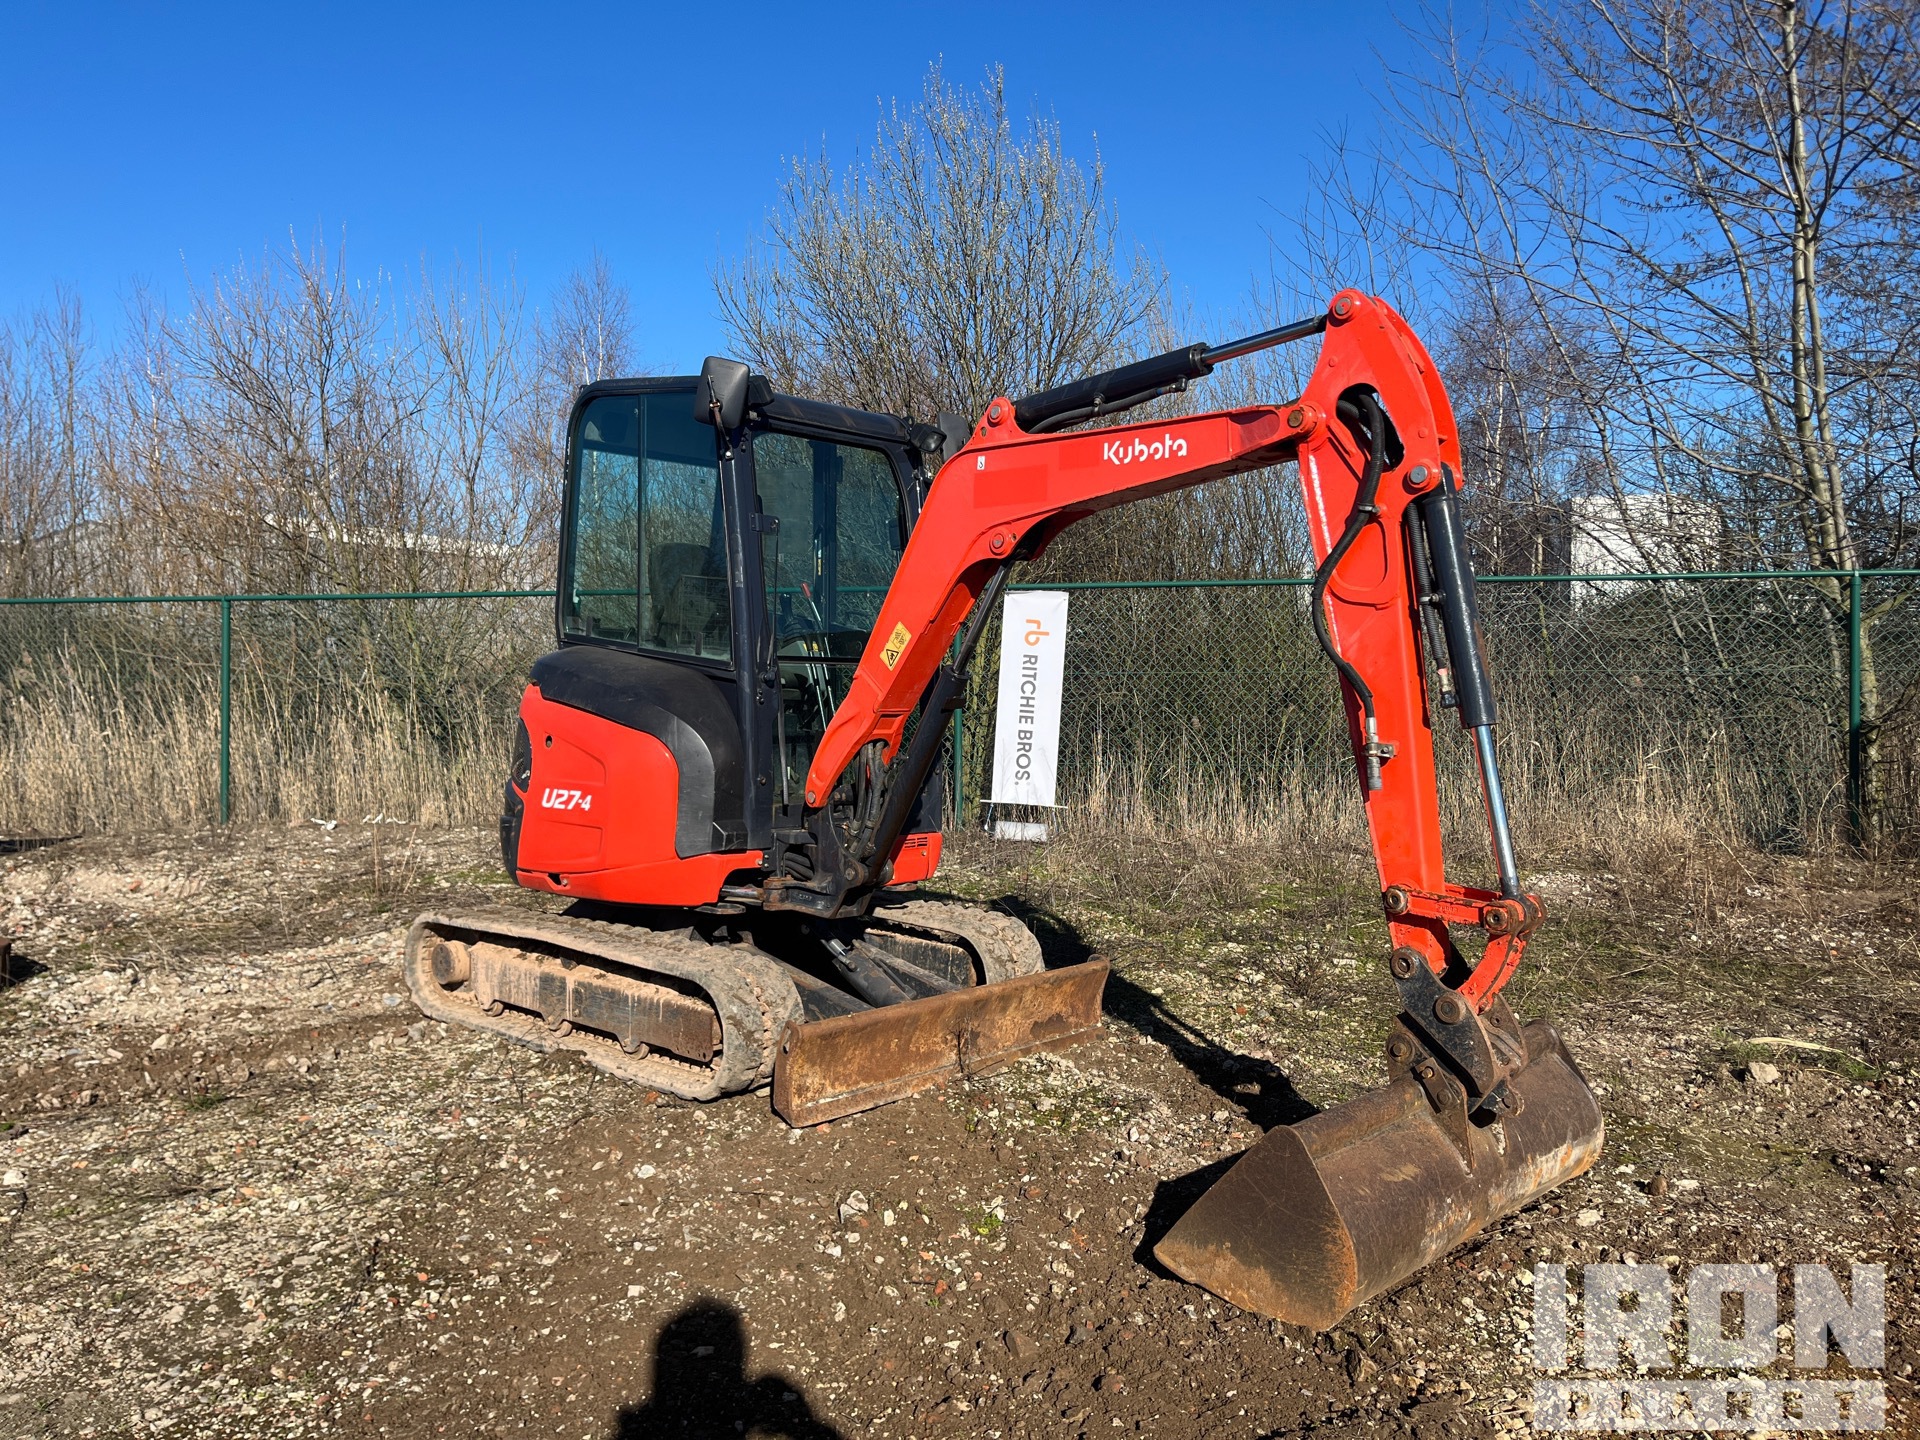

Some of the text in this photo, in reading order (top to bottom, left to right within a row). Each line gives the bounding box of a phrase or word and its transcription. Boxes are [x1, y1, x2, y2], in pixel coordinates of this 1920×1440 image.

[1103, 433, 1188, 465] Kubota
[1014, 654, 1039, 786] RITCHIE BROS.
[541, 788, 592, 811] U27-4
